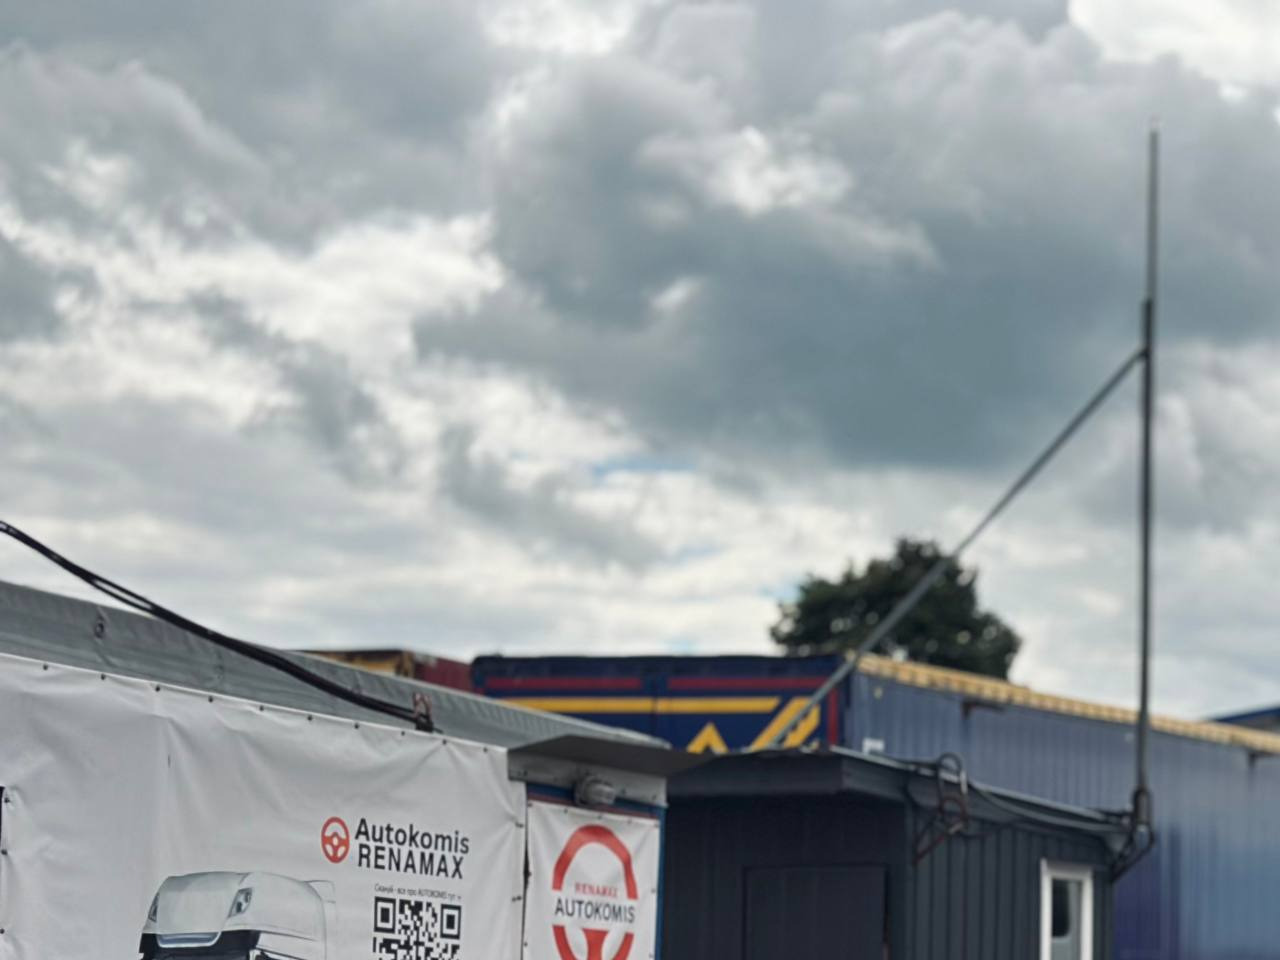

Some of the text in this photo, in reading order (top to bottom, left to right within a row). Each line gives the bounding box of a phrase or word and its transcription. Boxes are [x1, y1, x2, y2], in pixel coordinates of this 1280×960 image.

[355, 817, 470, 854] Autokomis
[358, 843, 464, 879] RENAMAX
[555, 898, 635, 923] AUTOKOMIS
